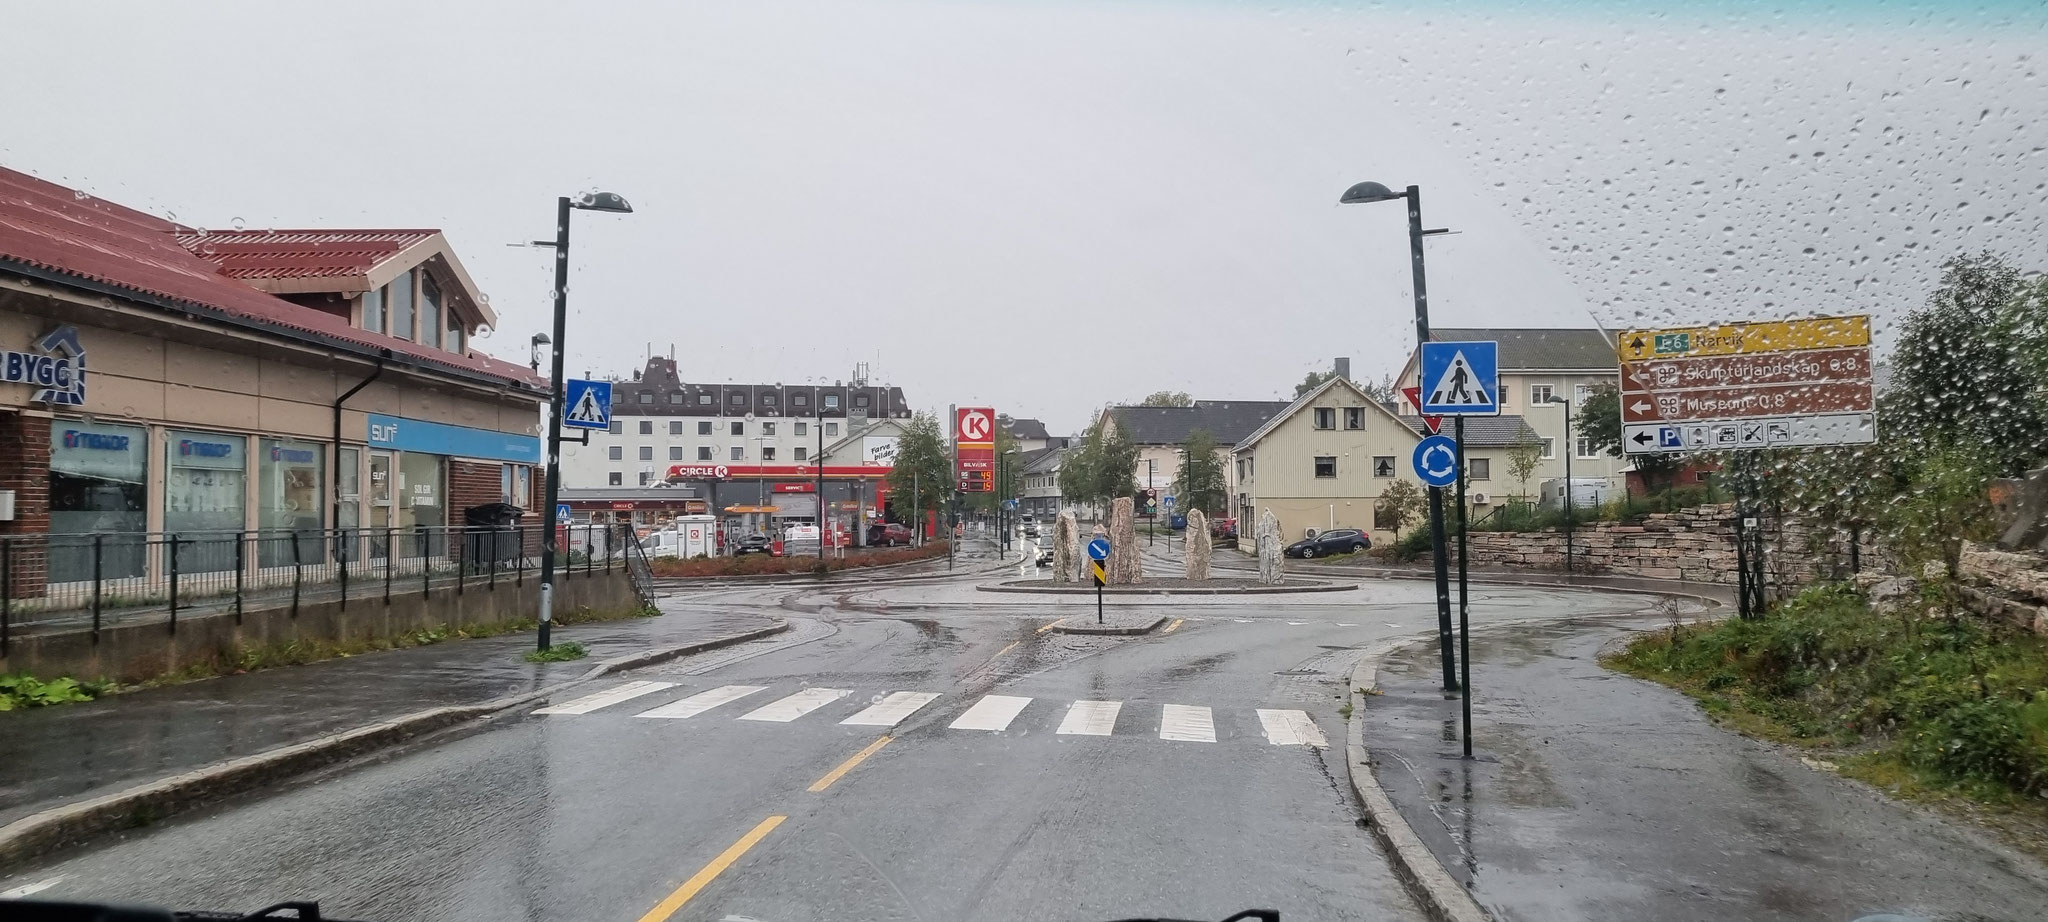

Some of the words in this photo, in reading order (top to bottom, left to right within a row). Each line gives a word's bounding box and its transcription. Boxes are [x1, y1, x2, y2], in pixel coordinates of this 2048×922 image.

[1695, 334, 1744, 347] Narvik
[6, 351, 70, 388] BYGG
[1686, 361, 1820, 381] Skulpturlandskap
[1830, 358, 1857, 372] 0,8
[1687, 398, 1750, 411] Museum
[1759, 394, 1785, 409] 0,8
[871, 444, 890, 454] Farve
[874, 450, 895, 460] bilder
[680, 468, 713, 476] CIRCLE
[716, 465, 727, 477] K
